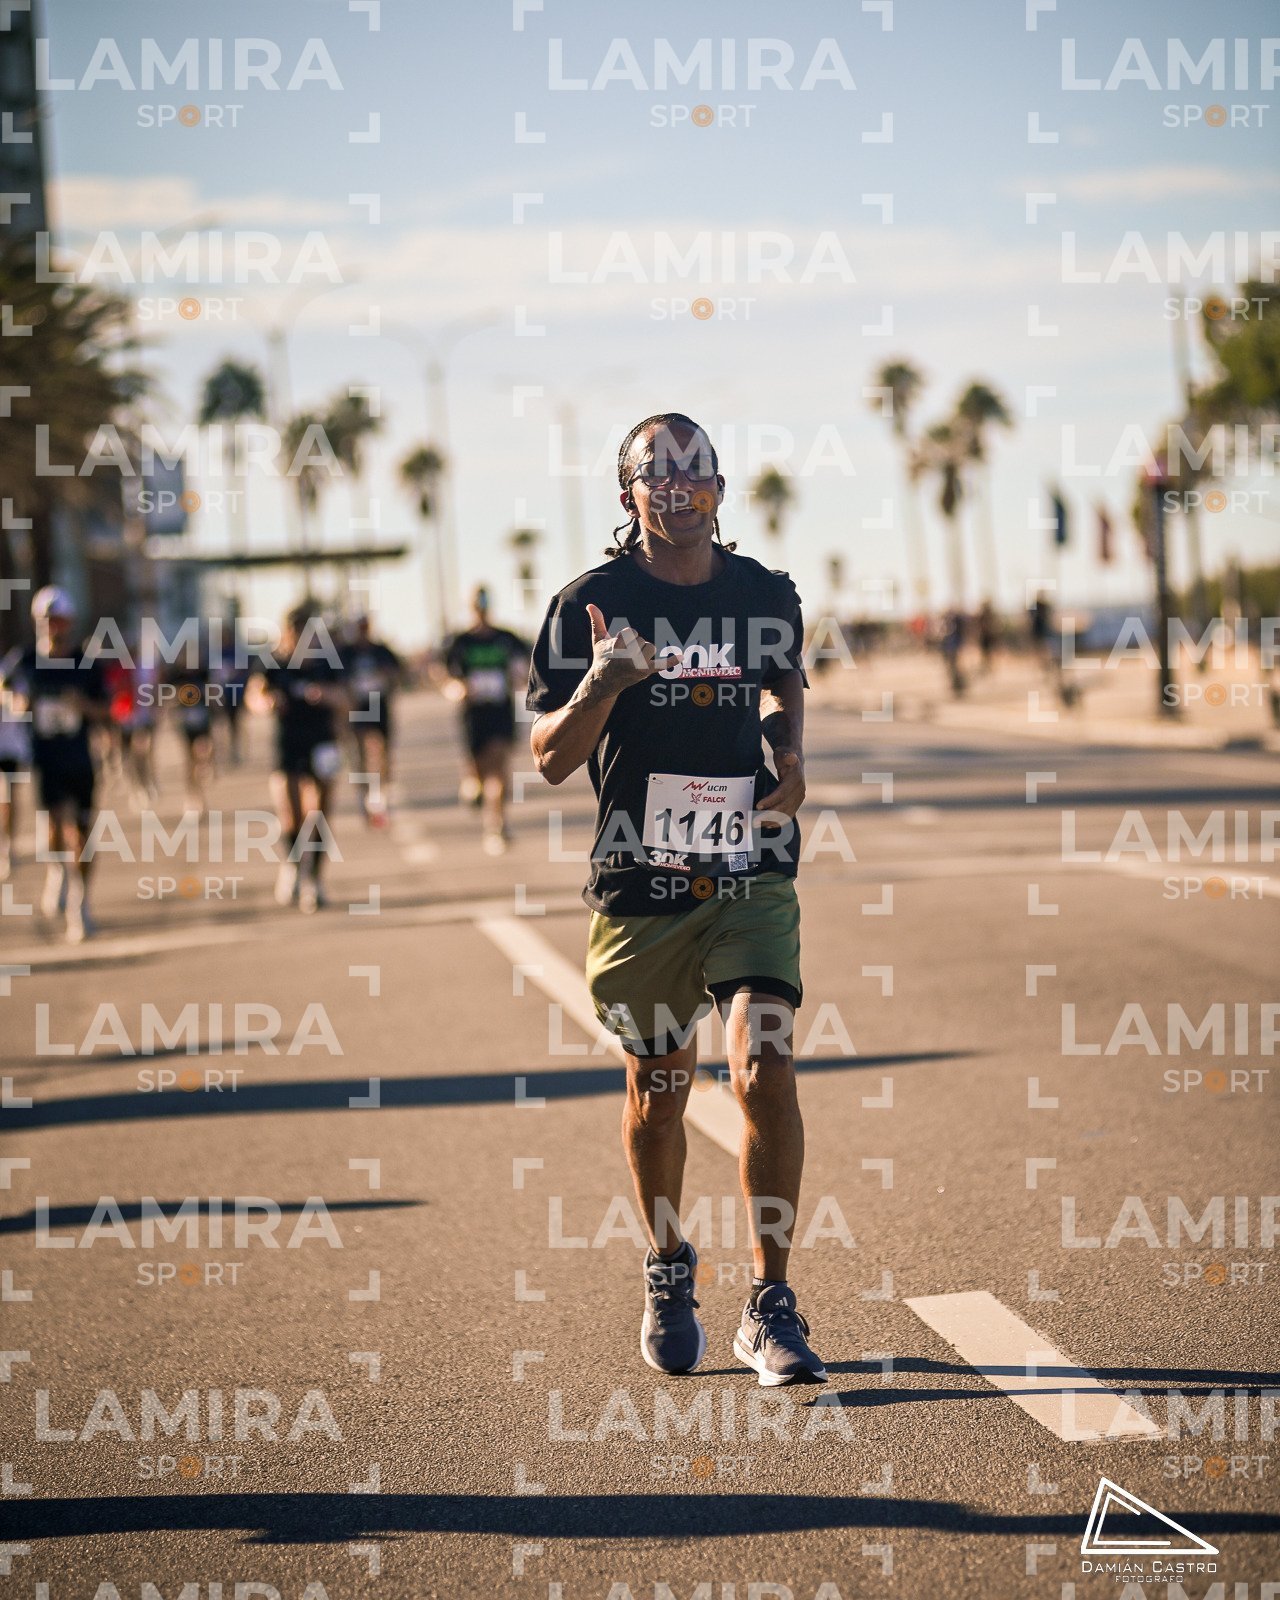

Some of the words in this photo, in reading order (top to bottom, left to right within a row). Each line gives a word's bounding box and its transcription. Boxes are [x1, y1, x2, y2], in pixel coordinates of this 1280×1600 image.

[658, 643, 735, 680] 30K
[655, 808, 744, 847] 1146
[648, 850, 689, 867] 30K
